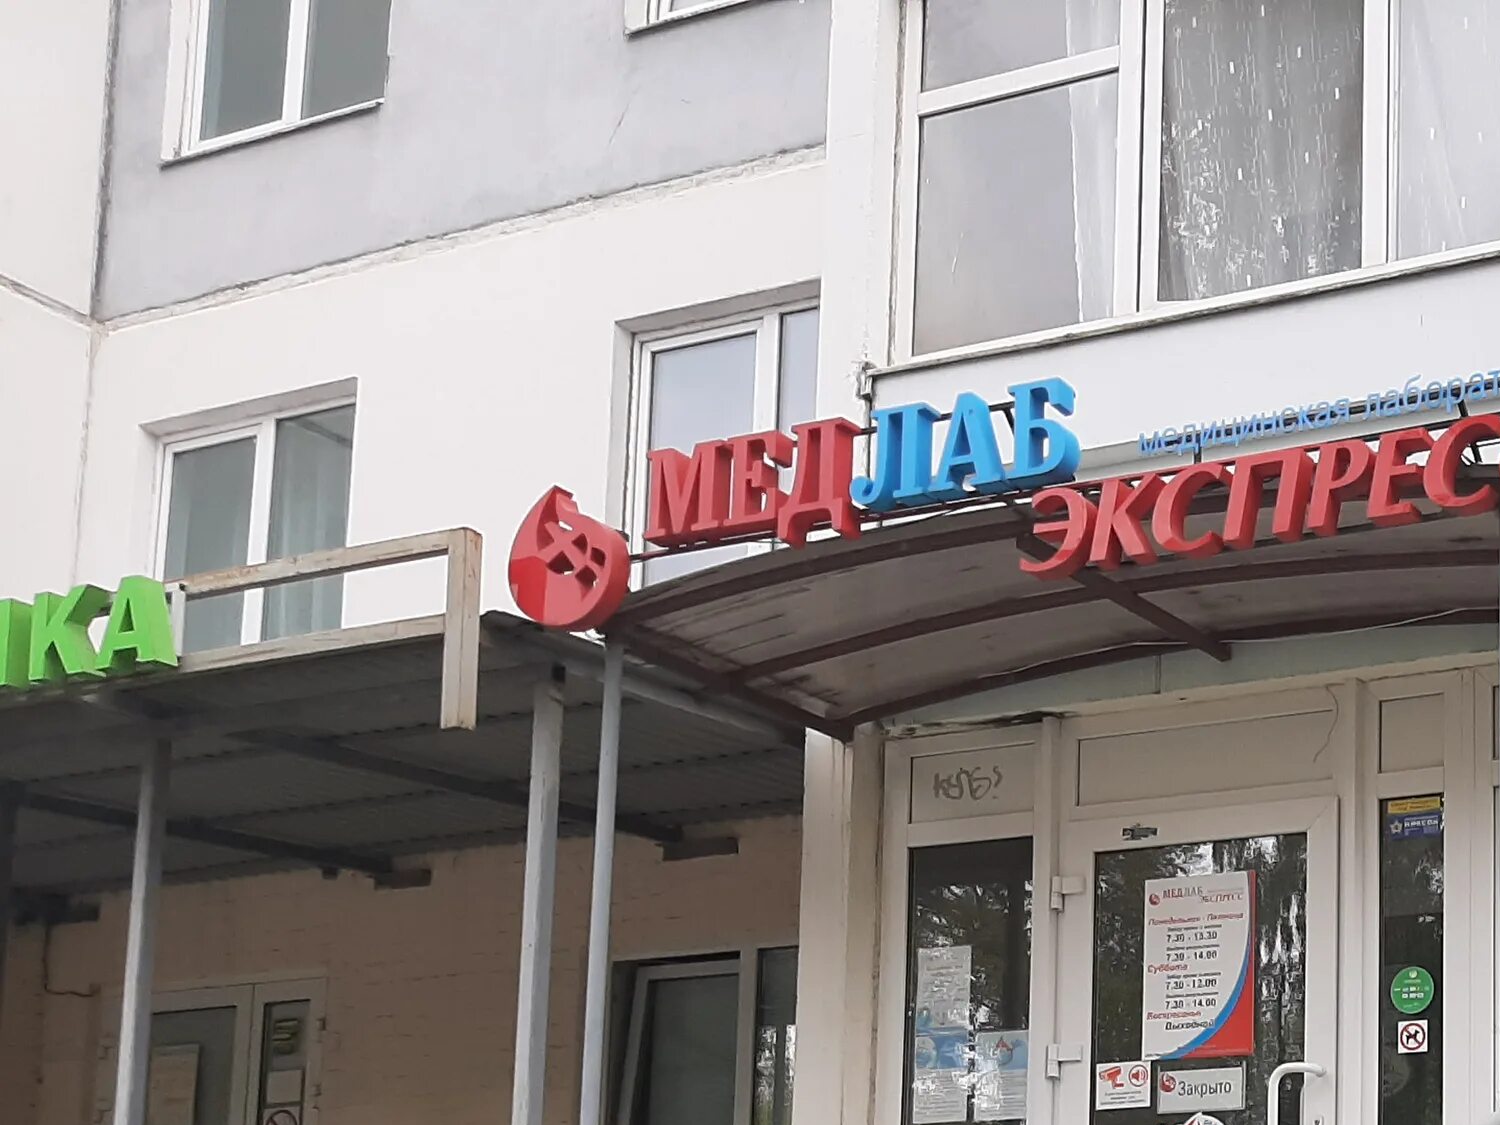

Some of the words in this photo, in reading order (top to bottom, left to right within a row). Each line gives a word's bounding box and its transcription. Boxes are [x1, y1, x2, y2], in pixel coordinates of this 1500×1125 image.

[1138, 397, 1350, 457] медицинская
[0, 574, 178, 691] КА
[1178, 1080, 1232, 1098] Закрыто
